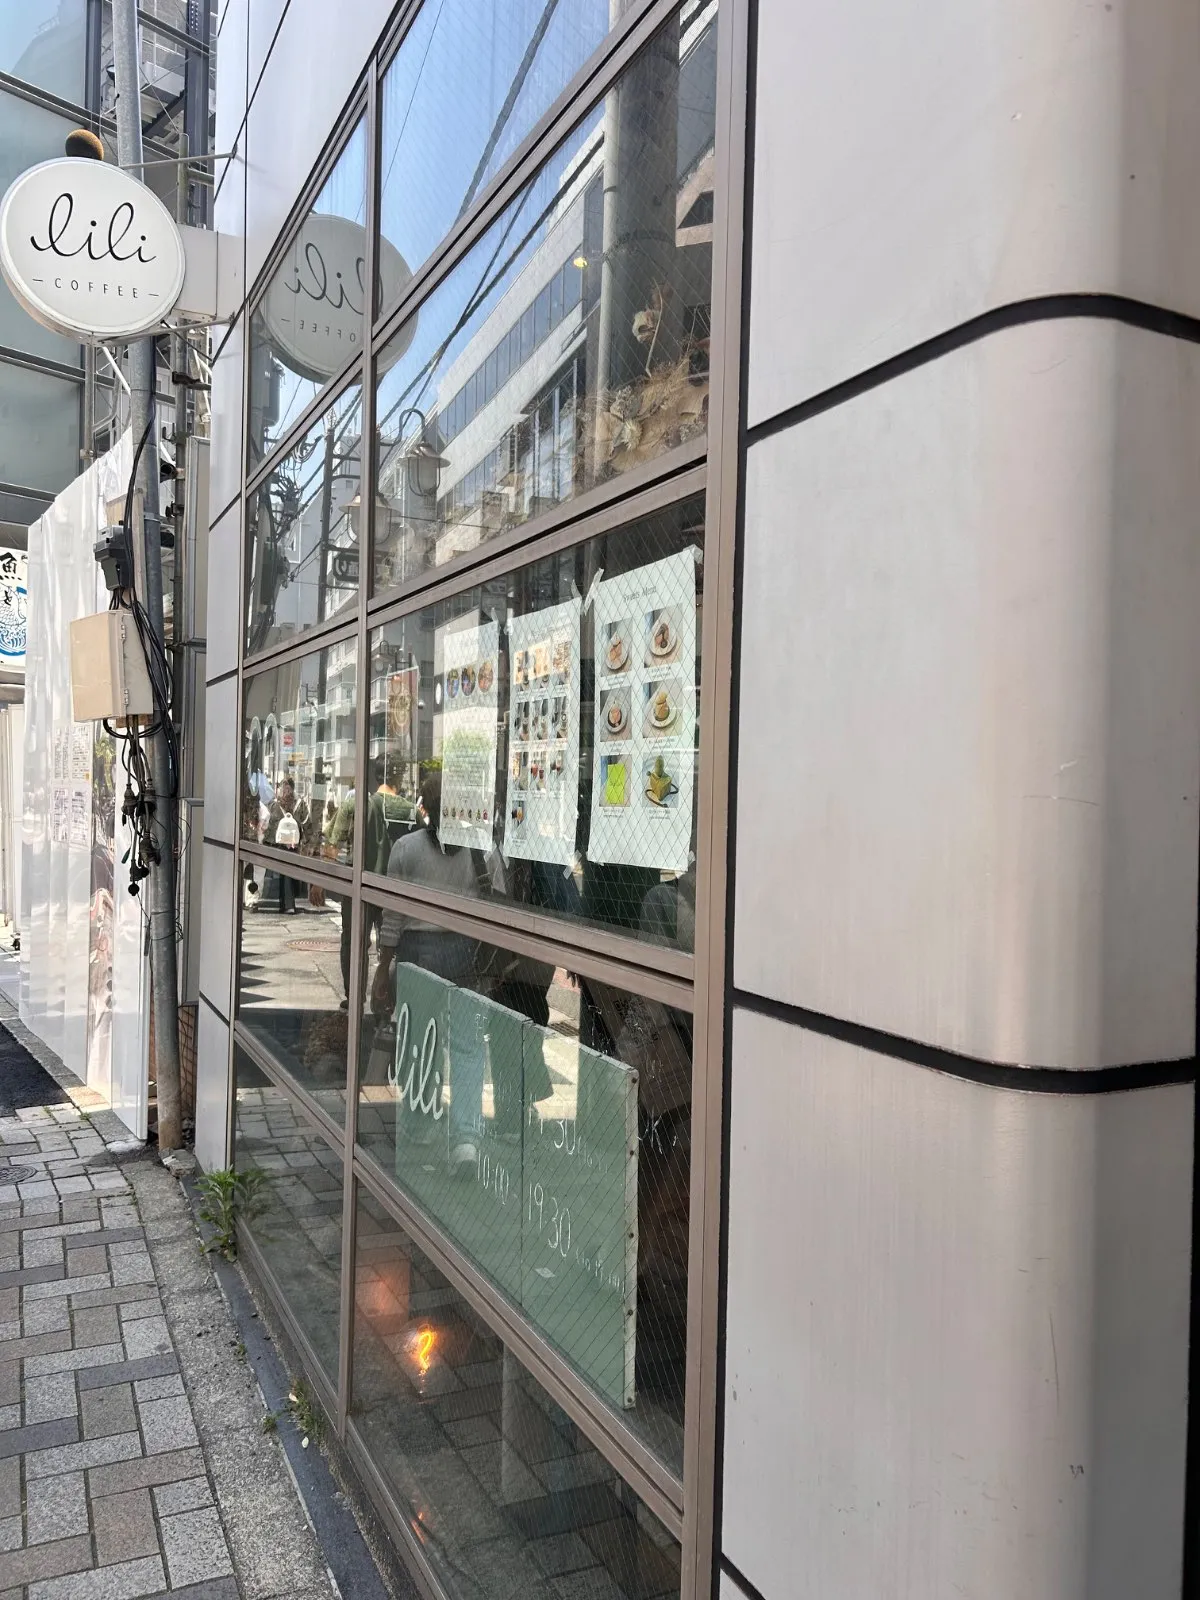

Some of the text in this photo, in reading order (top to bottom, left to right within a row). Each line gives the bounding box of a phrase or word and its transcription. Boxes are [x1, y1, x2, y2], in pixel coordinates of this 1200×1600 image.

[30, 192, 157, 263] lili
[54, 277, 139, 298] COFFEE
[388, 1003, 443, 1120] lili
